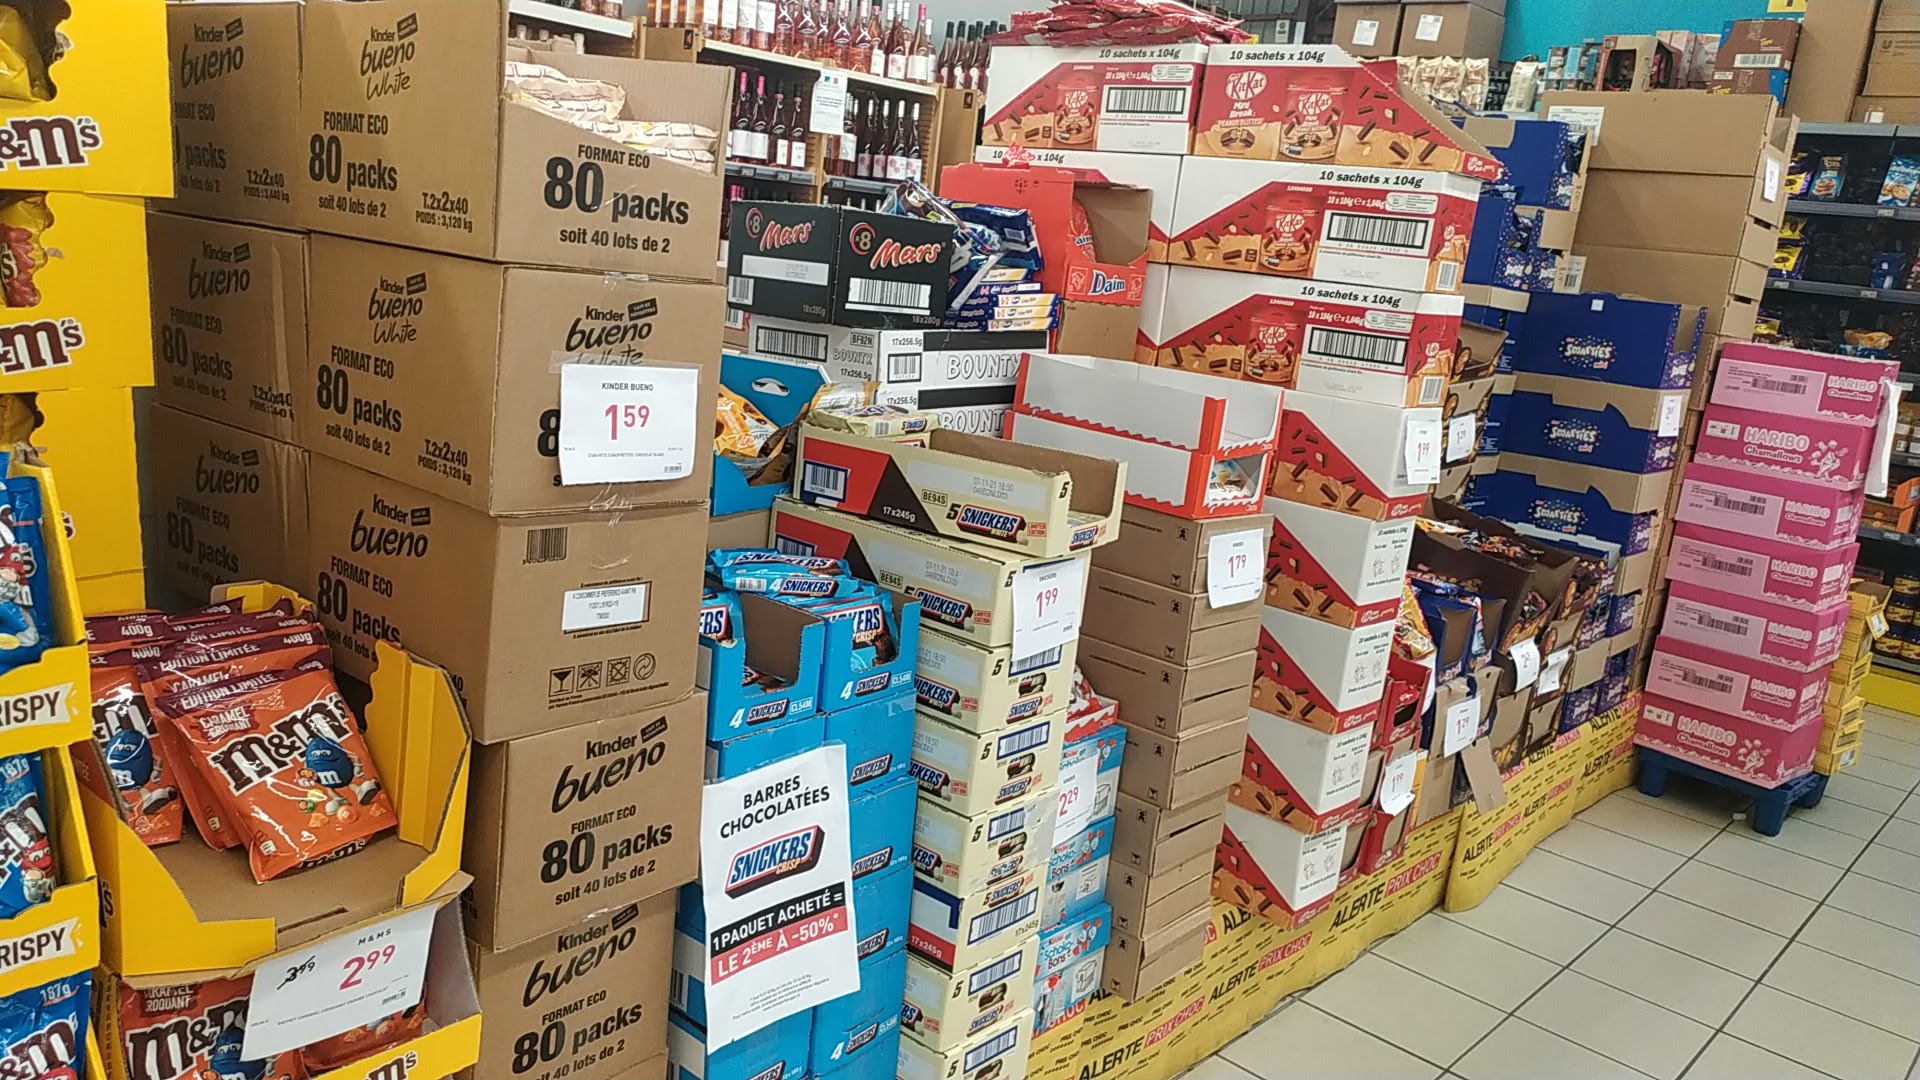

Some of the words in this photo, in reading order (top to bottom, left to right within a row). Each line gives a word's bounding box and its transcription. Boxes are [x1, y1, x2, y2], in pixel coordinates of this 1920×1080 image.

[194, 24, 224, 42] Kinder
[369, 26, 396, 43] Kinder
[180, 44, 244, 89] bueno
[360, 41, 415, 77] bueno
[1244, 50, 1286, 62] sachets
[1297, 50, 1325, 63] 104g
[366, 71, 412, 101] White
[1225, 71, 1267, 100] KitKat
[1298, 93, 1332, 115] KitKat
[323, 110, 364, 133] FORMAT
[367, 114, 389, 135] ECO
[309, 134, 342, 183] 80
[346, 159, 398, 192] packs
[577, 144, 625, 165] FORMAT
[627, 153, 650, 168] ECO
[543, 156, 604, 212] 80
[612, 190, 689, 224] packs
[1336, 173, 1380, 185] sachets
[1393, 175, 1424, 188] 104g
[559, 228, 587, 246] soit
[591, 229, 609, 247] 40
[612, 233, 638, 251] lots
[642, 235, 659, 253] de
[661, 237, 671, 253] 2
[760, 220, 812, 251] Mars
[870, 238, 942, 270] Mars
[189, 258, 250, 299] bueno
[379, 276, 404, 295] Kinder
[1089, 271, 1126, 295] Daim
[368, 288, 423, 321] bueno
[1317, 289, 1359, 303] sachets
[1372, 294, 1402, 309] 104g
[585, 305, 625, 322] Kinder
[373, 319, 418, 344] White
[565, 317, 653, 352] bueno
[331, 345, 371, 373] FORMAT
[373, 357, 394, 380] ECO
[832, 348, 872, 366] BOUNTY
[947, 354, 1020, 380] BOUNTY
[317, 364, 348, 415] 80
[353, 396, 402, 433] packs
[601, 382, 629, 391] KINDER
[630, 383, 653, 391] BUENO
[1828, 376, 1878, 394] HARIBO
[1828, 389, 1874, 401] Chamallows
[604, 404, 650, 441] 159
[1743, 427, 1810, 452] HARIBO
[1744, 446, 1803, 464] Chamallows
[195, 454, 259, 494] bueno
[372, 494, 408, 524] Kinder
[882, 506, 916, 522] 17x245g
[961, 506, 1019, 534] SNICKERS
[1785, 501, 1831, 519] HARIBO
[351, 508, 428, 557] bueno
[331, 555, 369, 586] FORMAT
[372, 572, 393, 598] ECO
[1228, 554, 1247, 579] 179
[1772, 559, 1817, 579] HARIBO
[317, 571, 348, 622] 80
[783, 580, 832, 594] SNICKERS
[1036, 587, 1058, 618] 199
[121, 624, 153, 637] 400g
[1767, 622, 1813, 642] HARIBO
[992, 658, 1004, 676] 5
[857, 673, 889, 693] SNICKERS
[1750, 678, 1797, 700] HARIBO
[199, 705, 250, 729] CARAMEL
[729, 708, 745, 728] 4
[748, 700, 787, 722] SNICKERS
[1677, 715, 1737, 747] HARIBO
[586, 735, 637, 760] Kinder
[981, 742, 992, 760] 5
[1677, 733, 1730, 758] Chamallows
[552, 741, 666, 813] bueno
[1581, 750, 1613, 780] ALERTE
[743, 776, 801, 810] BARRES
[1058, 787, 1079, 817] 229
[571, 811, 614, 834] FORMAT
[617, 805, 636, 821] ECO
[720, 786, 830, 839] CHOCOLATÉES
[1522, 797, 1548, 820] ALERTE
[540, 831, 595, 884] 80
[602, 823, 673, 870] packs
[730, 832, 813, 885] SNICKERS
[1462, 832, 1494, 863] ALERTE
[775, 858, 801, 875] CRISP
[555, 887, 581, 905] soit
[584, 881, 600, 896] 40
[603, 872, 627, 889] lots
[629, 865, 645, 879] de
[1329, 881, 1385, 932] ALERTE
[1387, 870, 1410, 896] PRIX
[1411, 853, 1440, 878] CHOC
[712, 934, 720, 952] 1
[721, 914, 775, 949] PAQUET
[777, 890, 831, 926] ACHETÉ
[557, 925, 609, 953] Kinder
[911, 935, 942, 958] 17x245g
[339, 944, 396, 991] 299
[523, 927, 637, 1008] bueno
[718, 956, 739, 979] LE
[742, 937, 774, 967] 2ÈME
[776, 929, 789, 951] À
[1047, 954, 1066, 970] Bons
[1208, 960, 1259, 1004] ALERTE
[1259, 948, 1283, 971] PRIX
[1283, 932, 1311, 957] CHOC
[541, 999, 584, 1026] FORMAT
[586, 990, 607, 1007] ECO
[511, 1020, 566, 1074] 80
[571, 1003, 642, 1056] packs
[1079, 1036, 1144, 1080] ALERTE
[1146, 1020, 1174, 1048] PRIX
[1175, 998, 1205, 1027] CHOC
[553, 1064, 570, 1080] 40
[572, 1055, 596, 1073] lots
[599, 1047, 614, 1062] de
